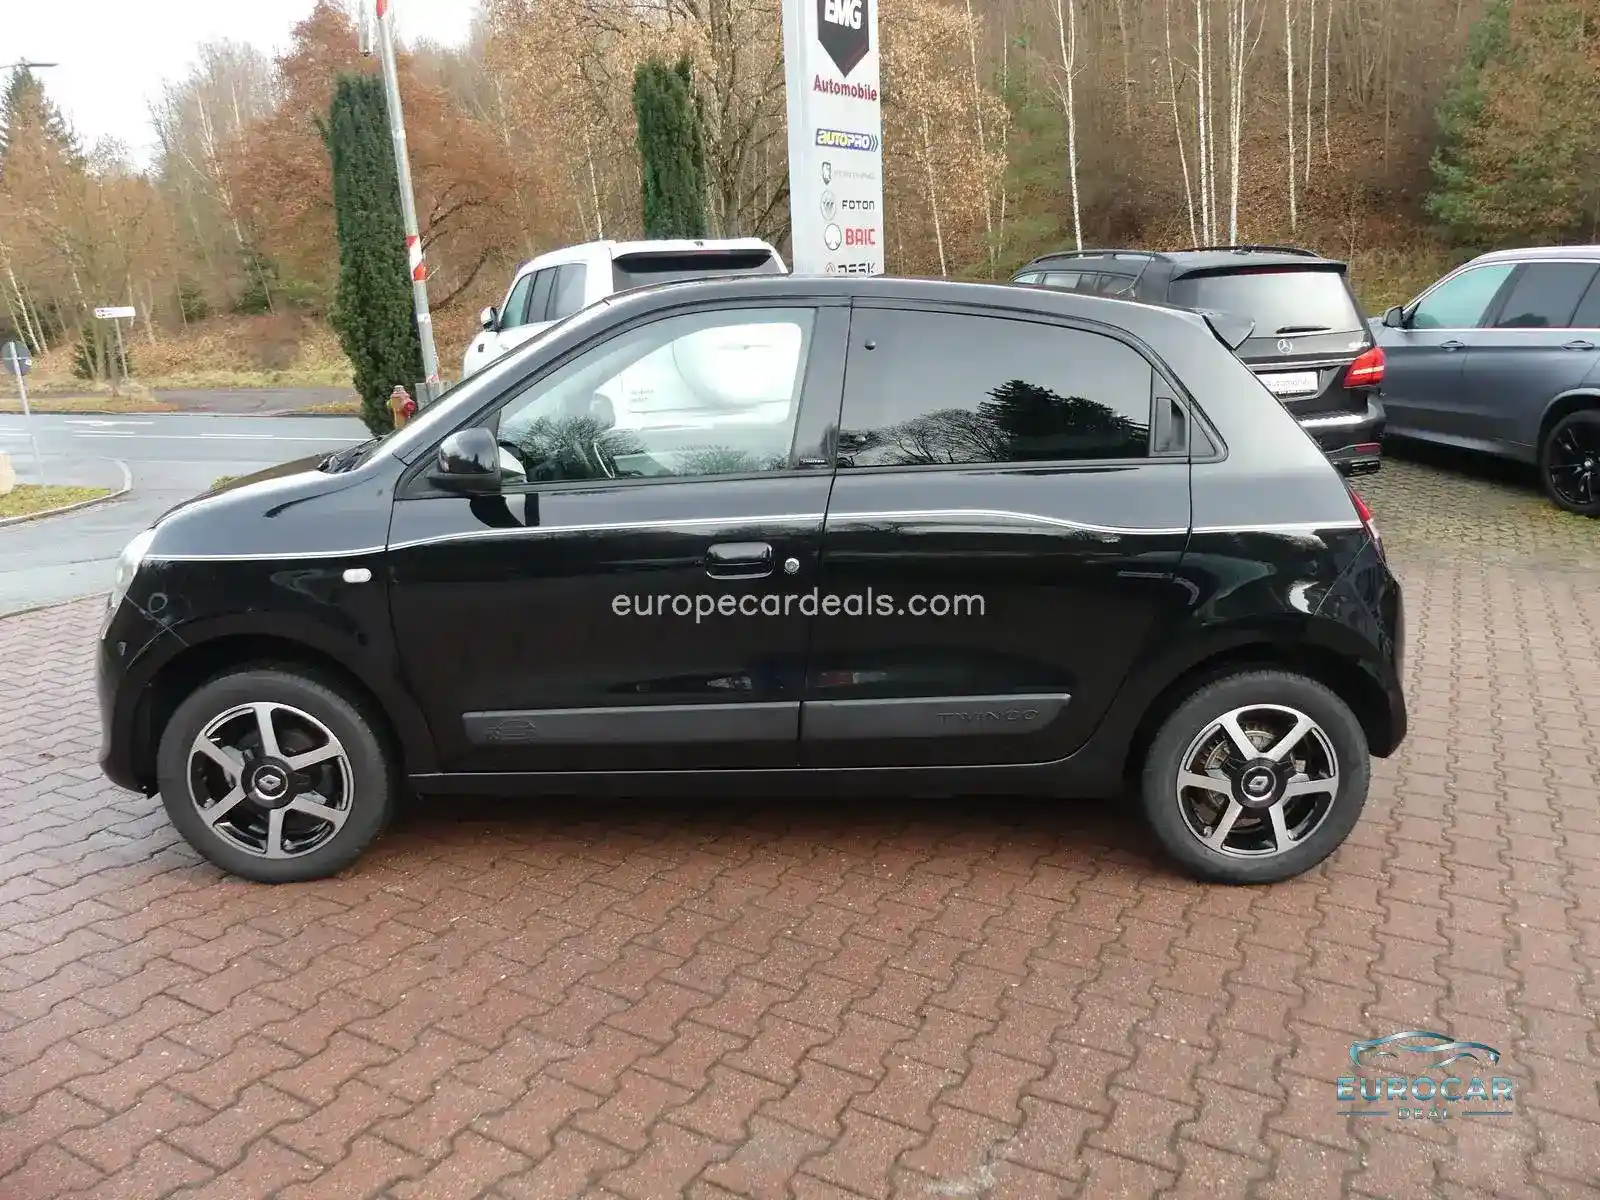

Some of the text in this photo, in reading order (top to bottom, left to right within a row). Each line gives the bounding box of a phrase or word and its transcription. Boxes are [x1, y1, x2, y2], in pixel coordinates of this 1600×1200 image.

[825, 0, 862, 30] EMG
[813, 74, 877, 101] Automobile
[842, 200, 875, 210] FOTON
[846, 228, 876, 246] BAIC
